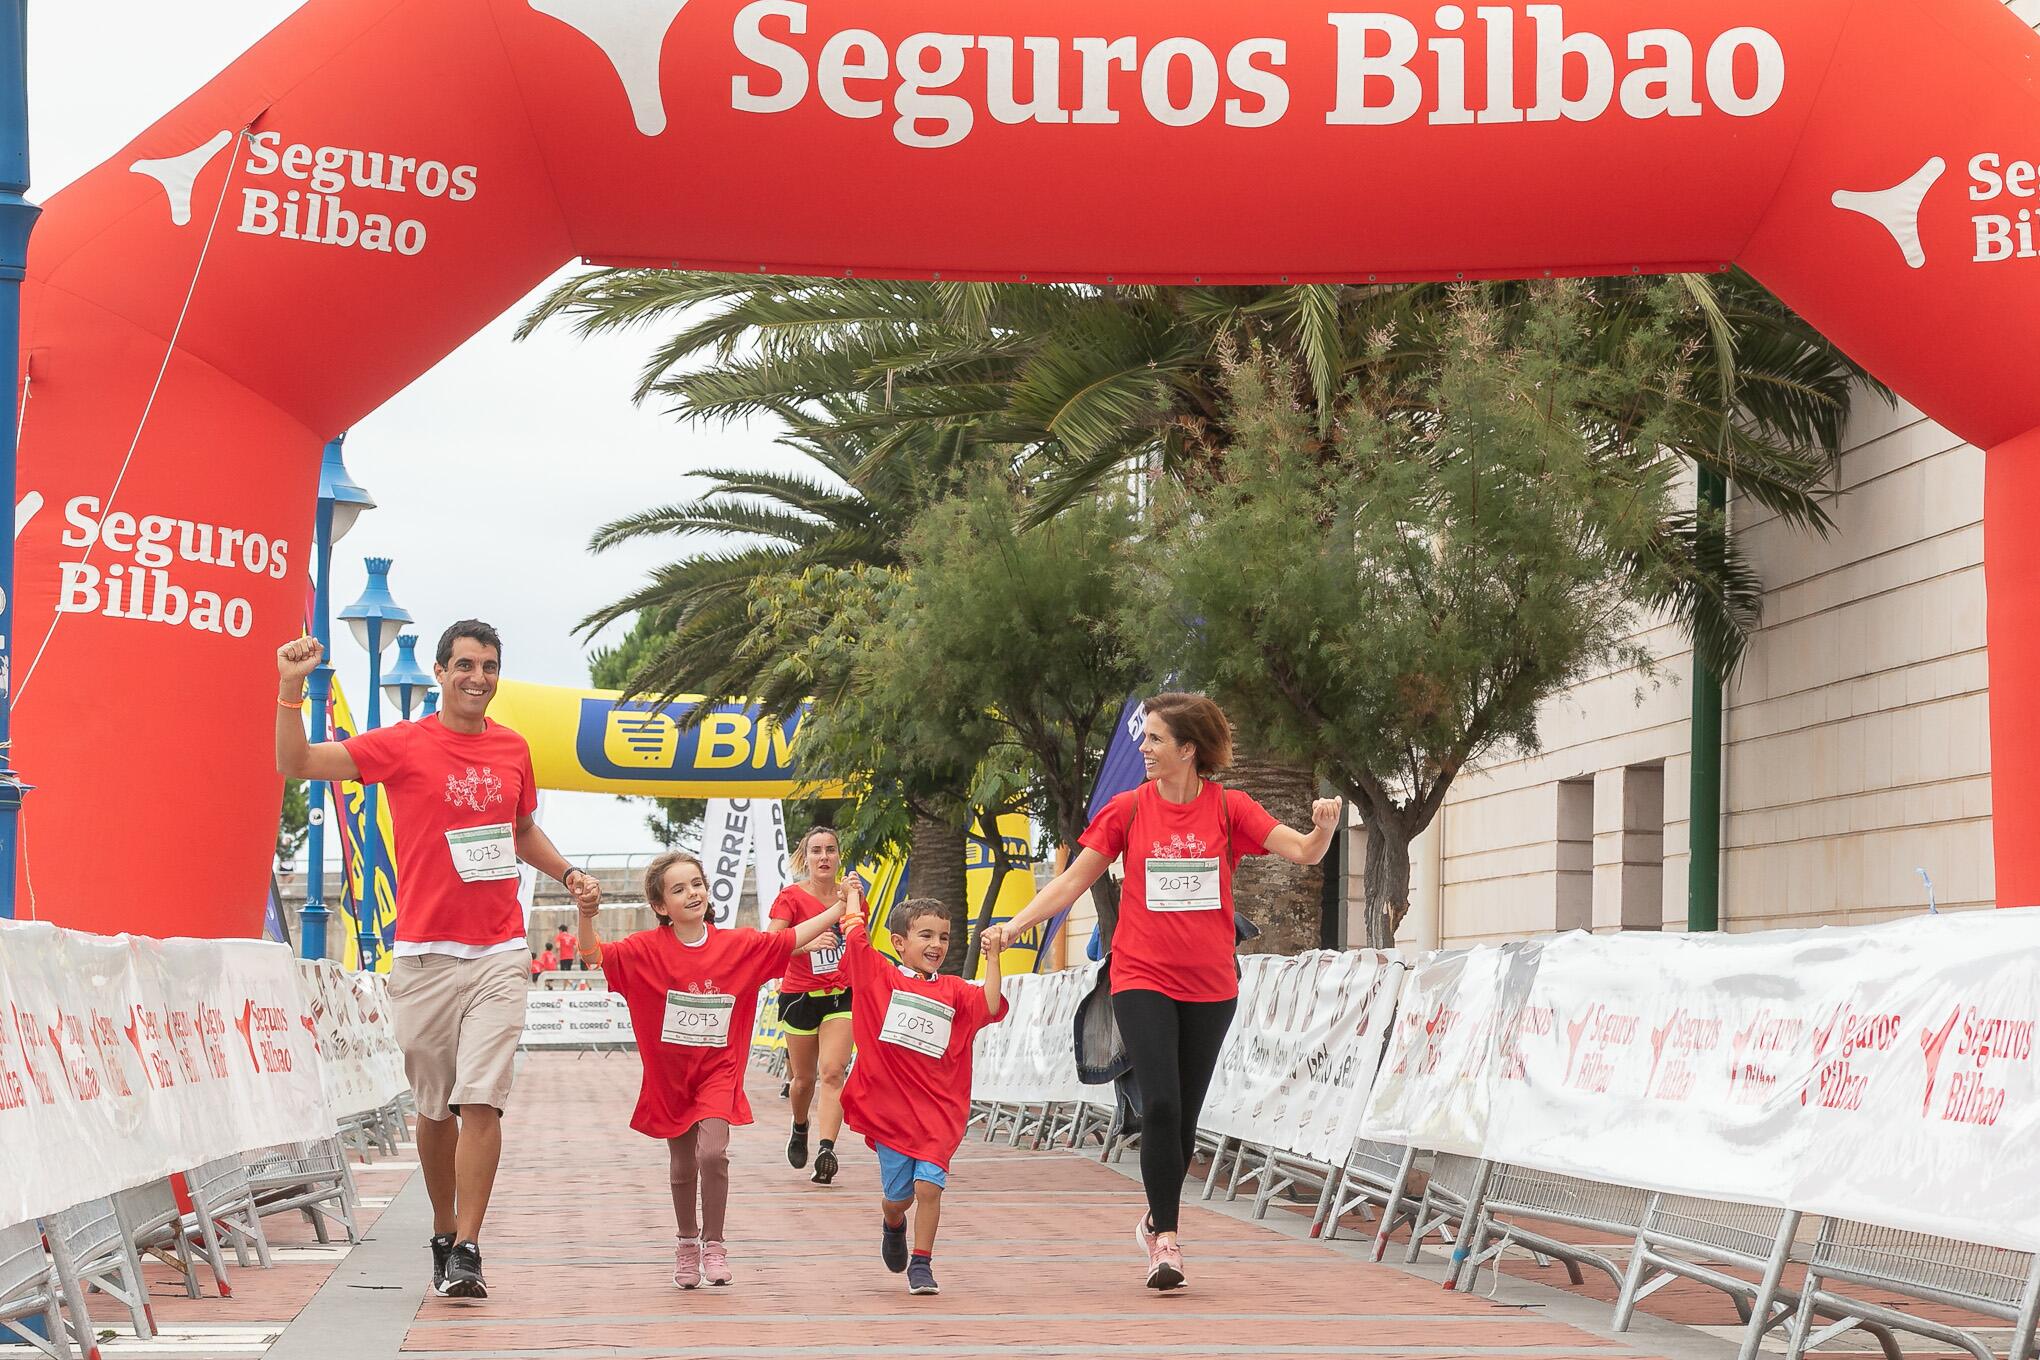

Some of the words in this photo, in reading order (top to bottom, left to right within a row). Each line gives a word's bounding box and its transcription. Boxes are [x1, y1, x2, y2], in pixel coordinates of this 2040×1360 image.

[732, 0, 1290, 149] Seguros
[1325, 4, 1785, 127] Bilbao
[245, 130, 479, 202] Seguros
[1967, 152, 2040, 201] Se
[236, 187, 427, 256] Bilbao
[1971, 208, 2040, 263] Bi
[62, 495, 289, 580] Seguros
[55, 561, 254, 638] Bilbao
[465, 844, 501, 863] 2073
[1159, 875, 1202, 893] 2073
[816, 945, 846, 965] 100
[531, 1023, 562, 1031] CORREO
[568, 1001, 578, 1009] EL
[578, 1001, 609, 1009] CORREO
[569, 1022, 578, 1030] EL
[579, 1022, 610, 1030] CORREO
[676, 1010, 720, 1028] 2073
[897, 1012, 935, 1035] 2073
[1958, 1005, 2035, 1068] Seguros
[1941, 1070, 2006, 1127] Bilbao
